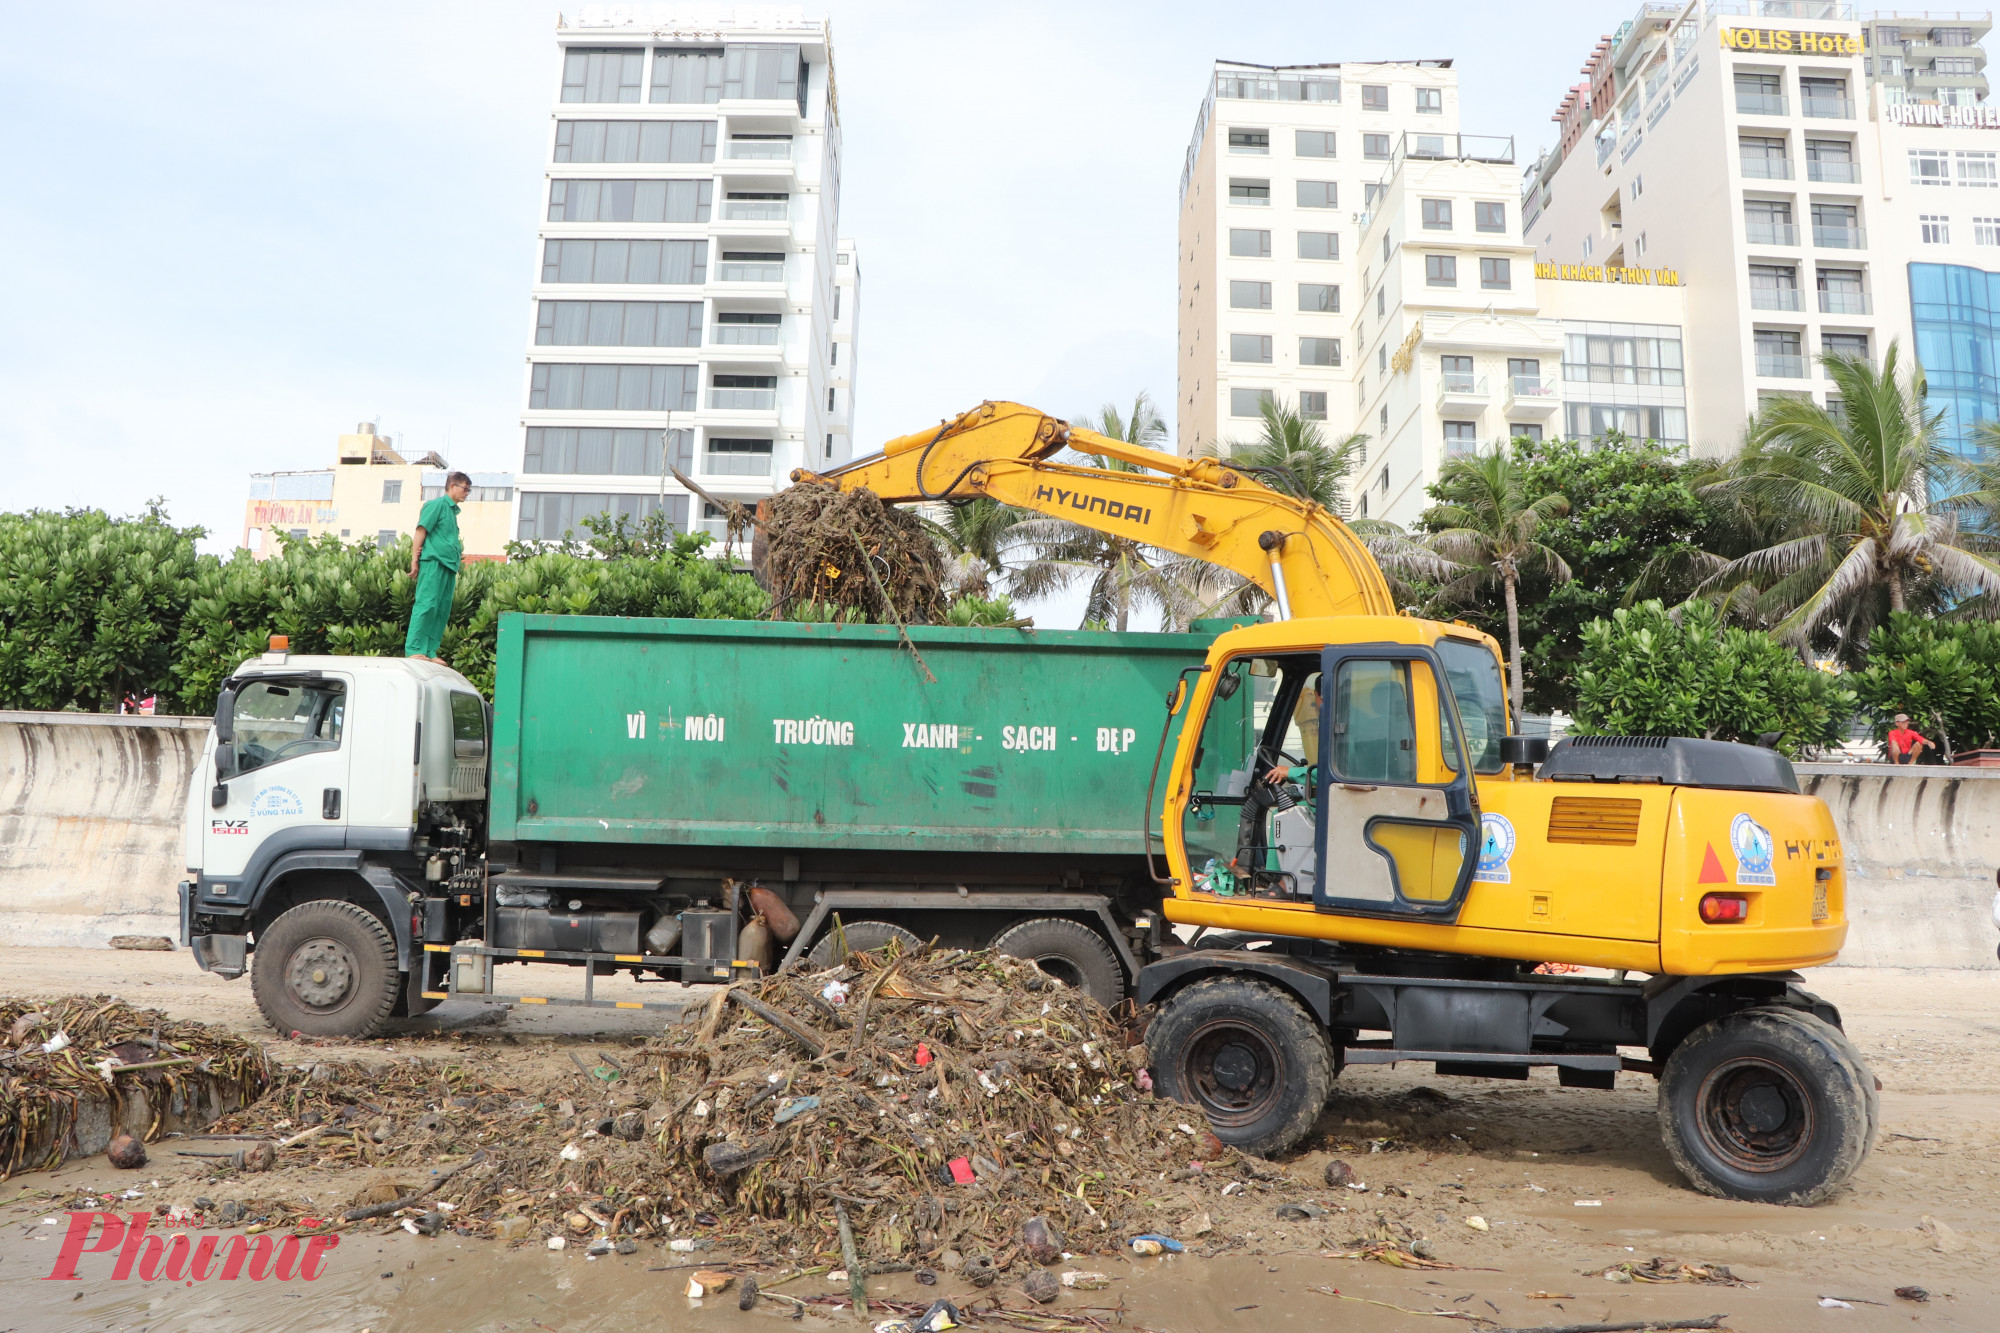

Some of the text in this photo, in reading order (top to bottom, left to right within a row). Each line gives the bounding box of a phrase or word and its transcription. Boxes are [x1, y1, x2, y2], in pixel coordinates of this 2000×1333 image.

[1719, 28, 1865, 54] NOLIS Hotel
[1535, 258, 1558, 280] NHÀ
[1561, 261, 1602, 283] KHÁCH
[1606, 266, 1617, 283] 17
[1620, 263, 1651, 285] THÙY
[1036, 484, 1151, 525] HYUNDAI
[626, 710, 646, 739] VÌ
[684, 713, 725, 742] MÔI
[773, 714, 854, 746] TRƯỜNG
[901, 723, 958, 749] XANH
[1002, 725, 1057, 754] SẠCH
[1096, 727, 1136, 755] ĐẸP
[1741, 875, 1772, 883] VESCO
